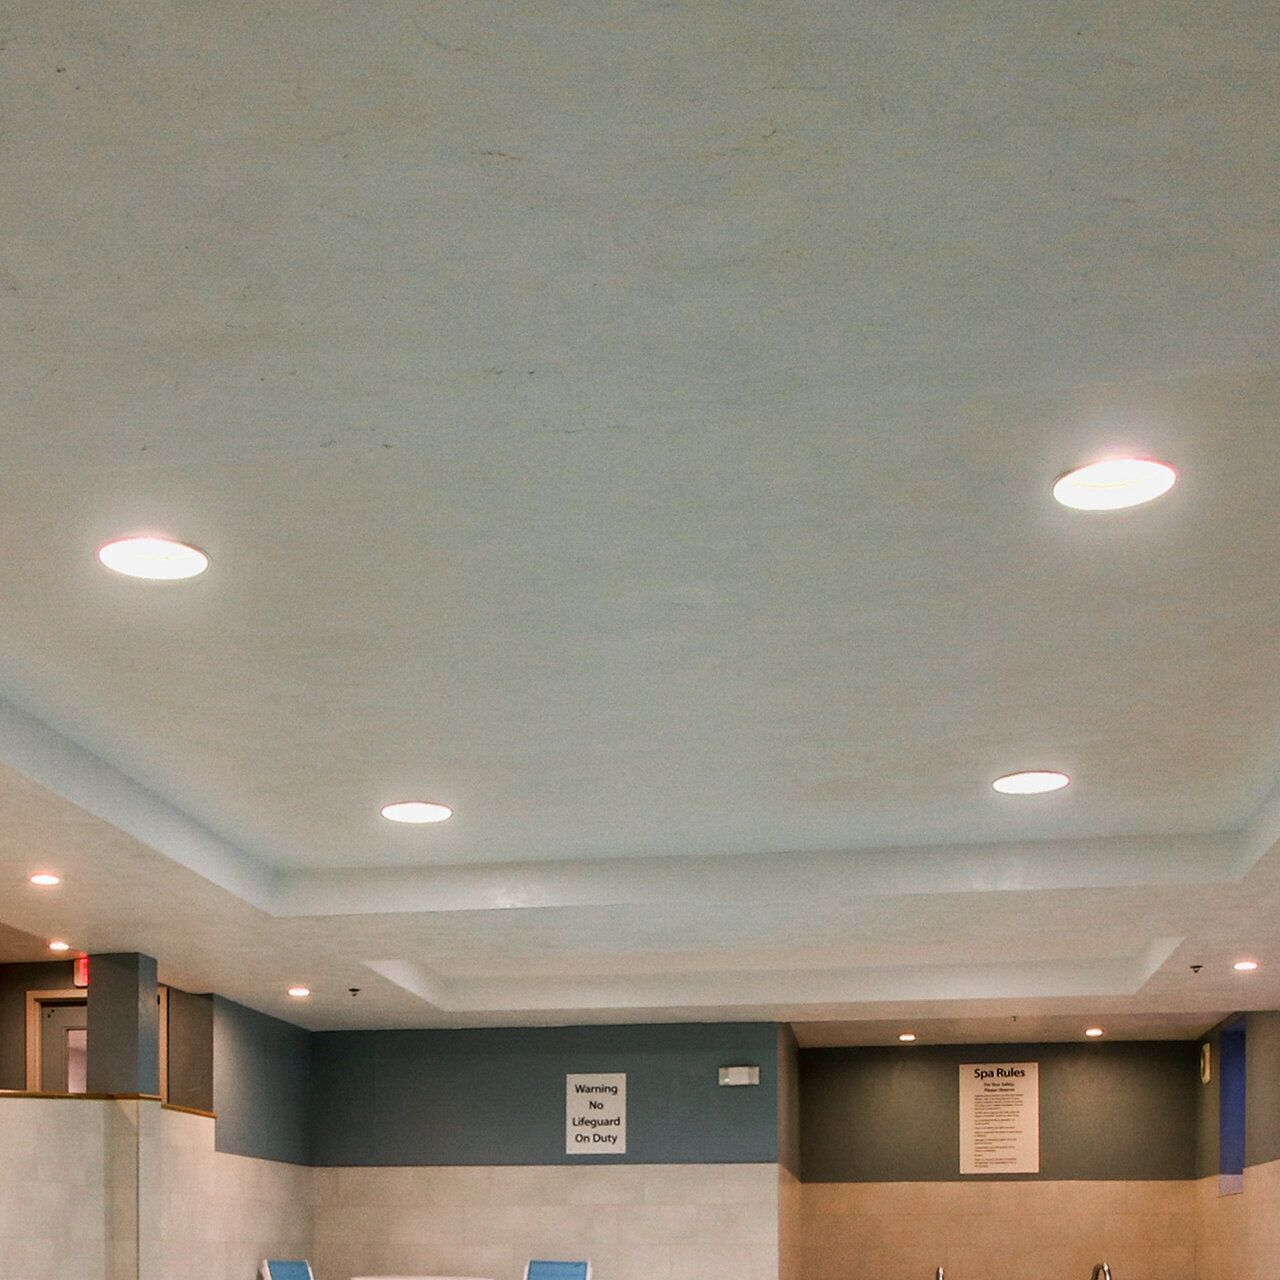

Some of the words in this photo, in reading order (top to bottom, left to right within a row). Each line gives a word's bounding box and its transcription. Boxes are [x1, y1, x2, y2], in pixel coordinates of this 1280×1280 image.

[974, 1068, 994, 1080] Spa
[996, 1068, 1026, 1078] Rules
[575, 1084, 618, 1095] Warning
[589, 1101, 604, 1110] No
[572, 1116, 621, 1129] Lifeguard
[575, 1133, 591, 1143] On
[592, 1133, 618, 1145] Duty
